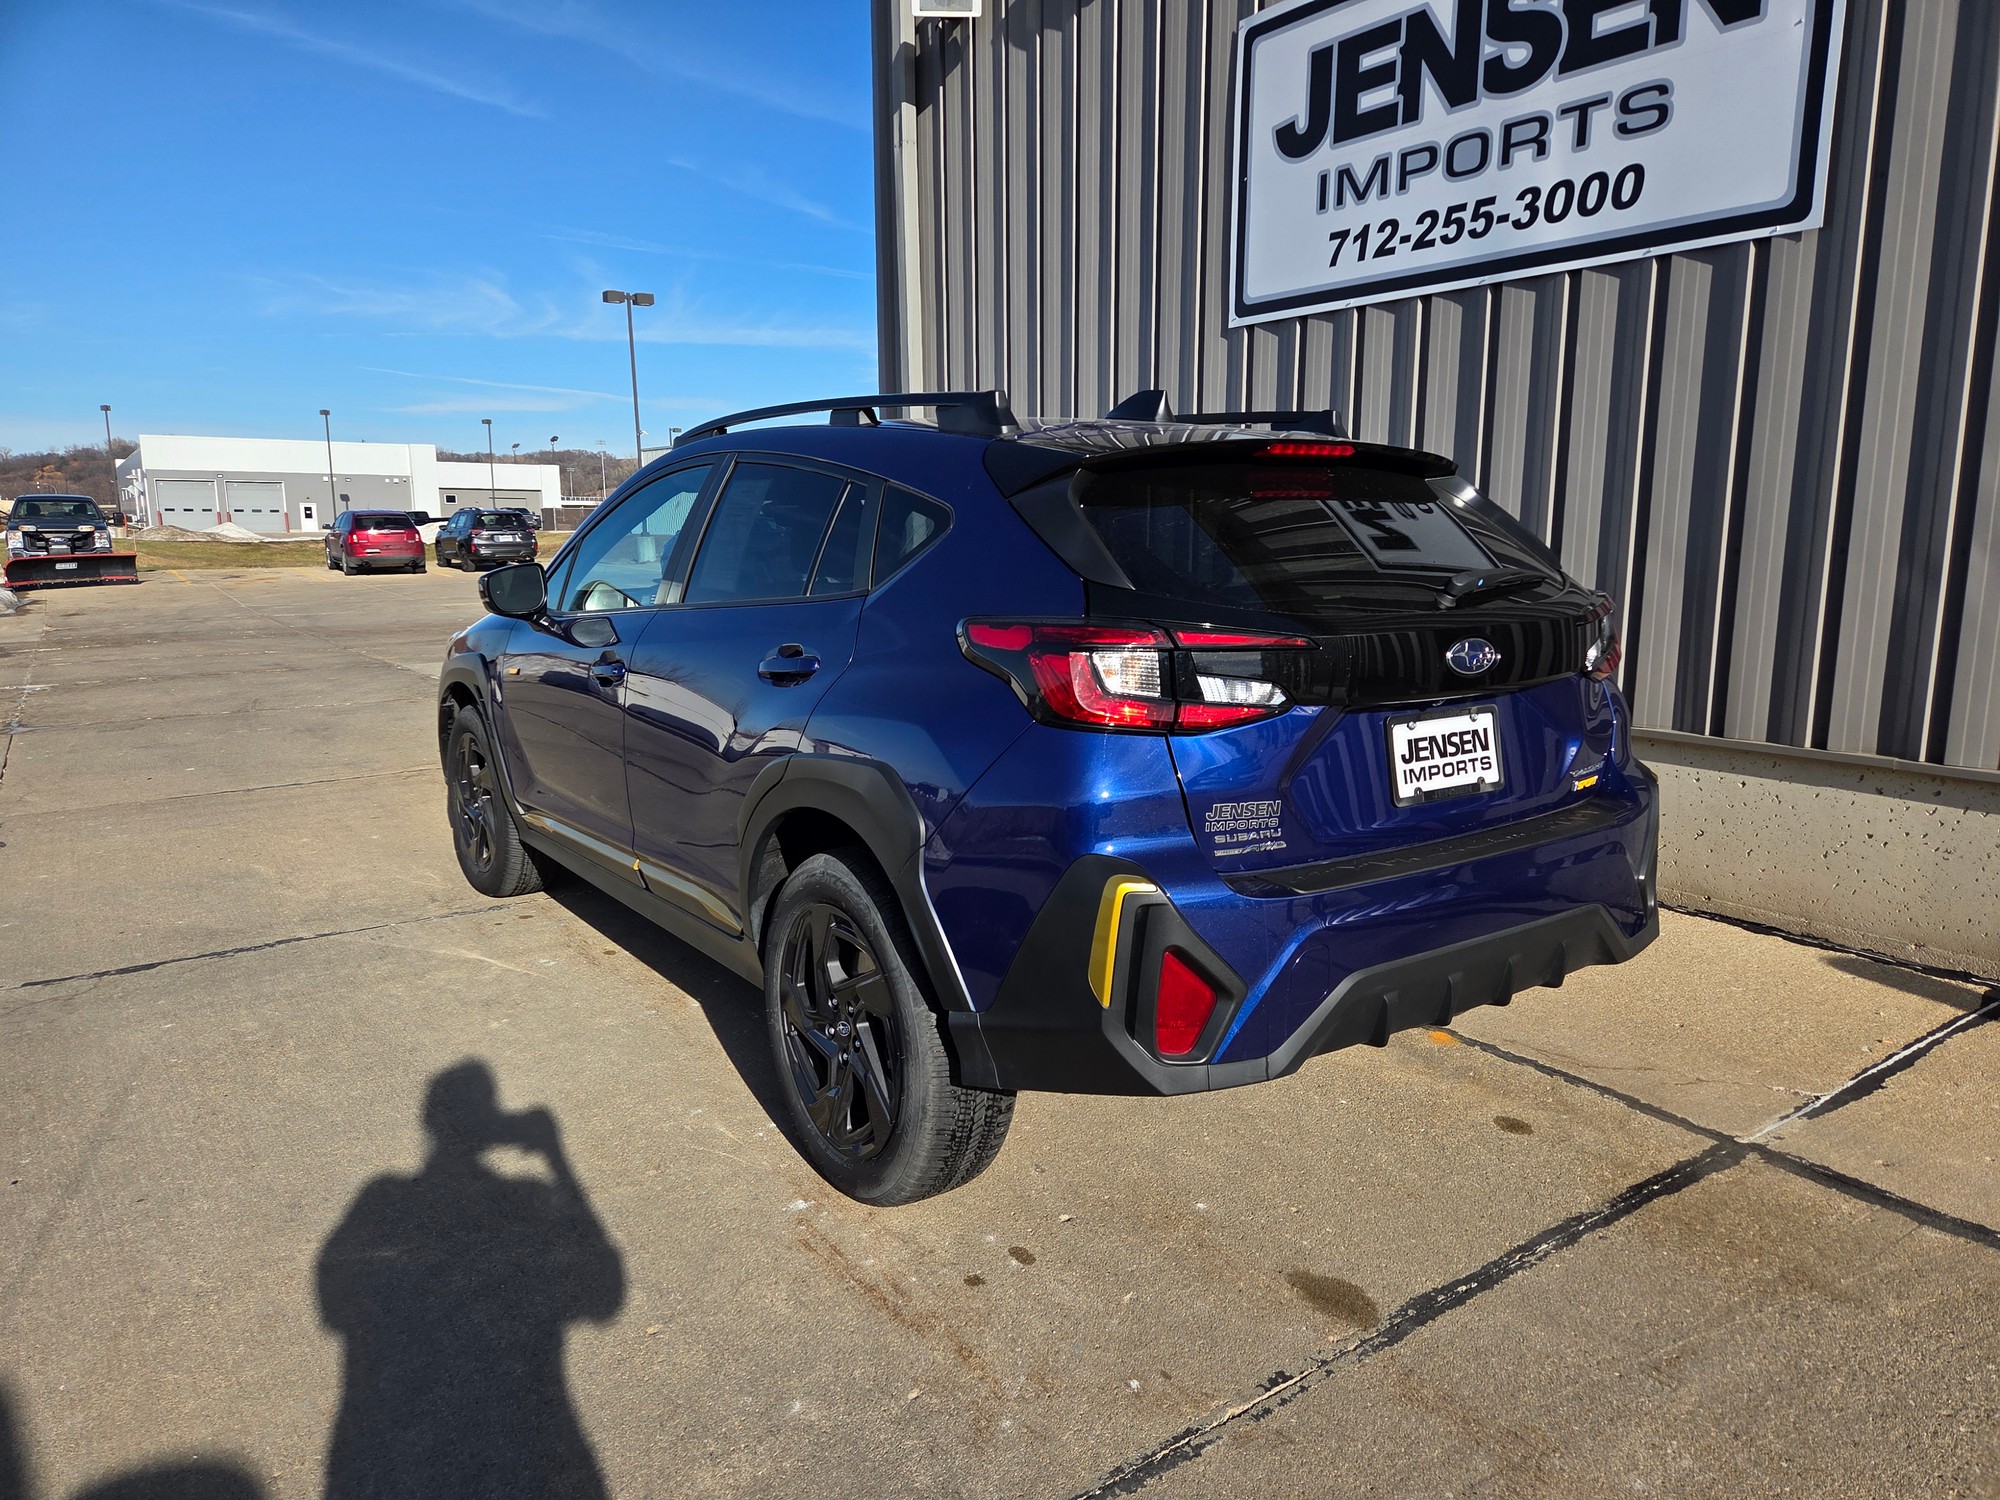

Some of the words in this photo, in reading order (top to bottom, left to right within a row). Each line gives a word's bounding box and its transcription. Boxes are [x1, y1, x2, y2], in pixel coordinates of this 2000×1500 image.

[1274, 0, 1763, 160] JENSE
[1317, 80, 1671, 214] IMPORTS
[1328, 163, 1645, 268] 712-255-3000
[1400, 727, 1490, 765] JENSEN
[1403, 755, 1492, 785] IMPORTS
[1205, 800, 1281, 820] JENSEN
[1205, 818, 1279, 832] IMPORTS
[1214, 828, 1282, 843] SUBARU
